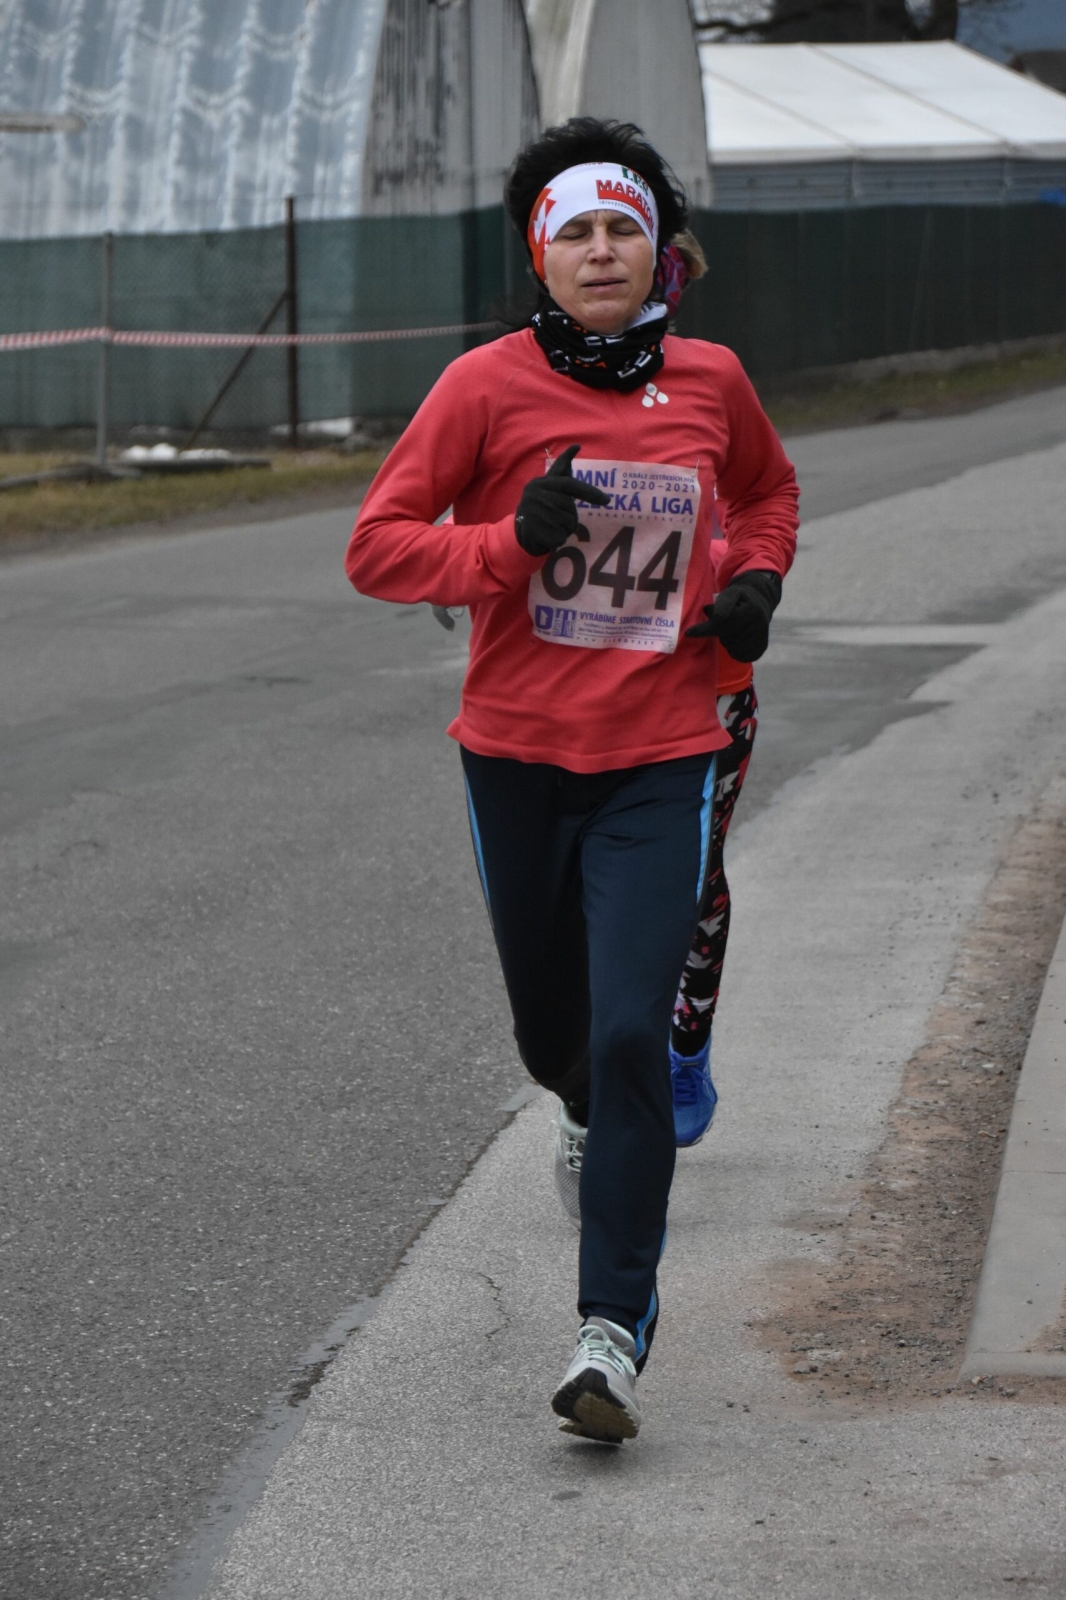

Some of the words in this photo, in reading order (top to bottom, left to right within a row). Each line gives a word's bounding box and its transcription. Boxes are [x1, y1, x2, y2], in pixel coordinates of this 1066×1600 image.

[651, 496, 694, 515] LIGA
[541, 522, 682, 611] 644
[579, 611, 616, 624] VYRÁBÍME
[655, 616, 675, 628] ČÍSLA
